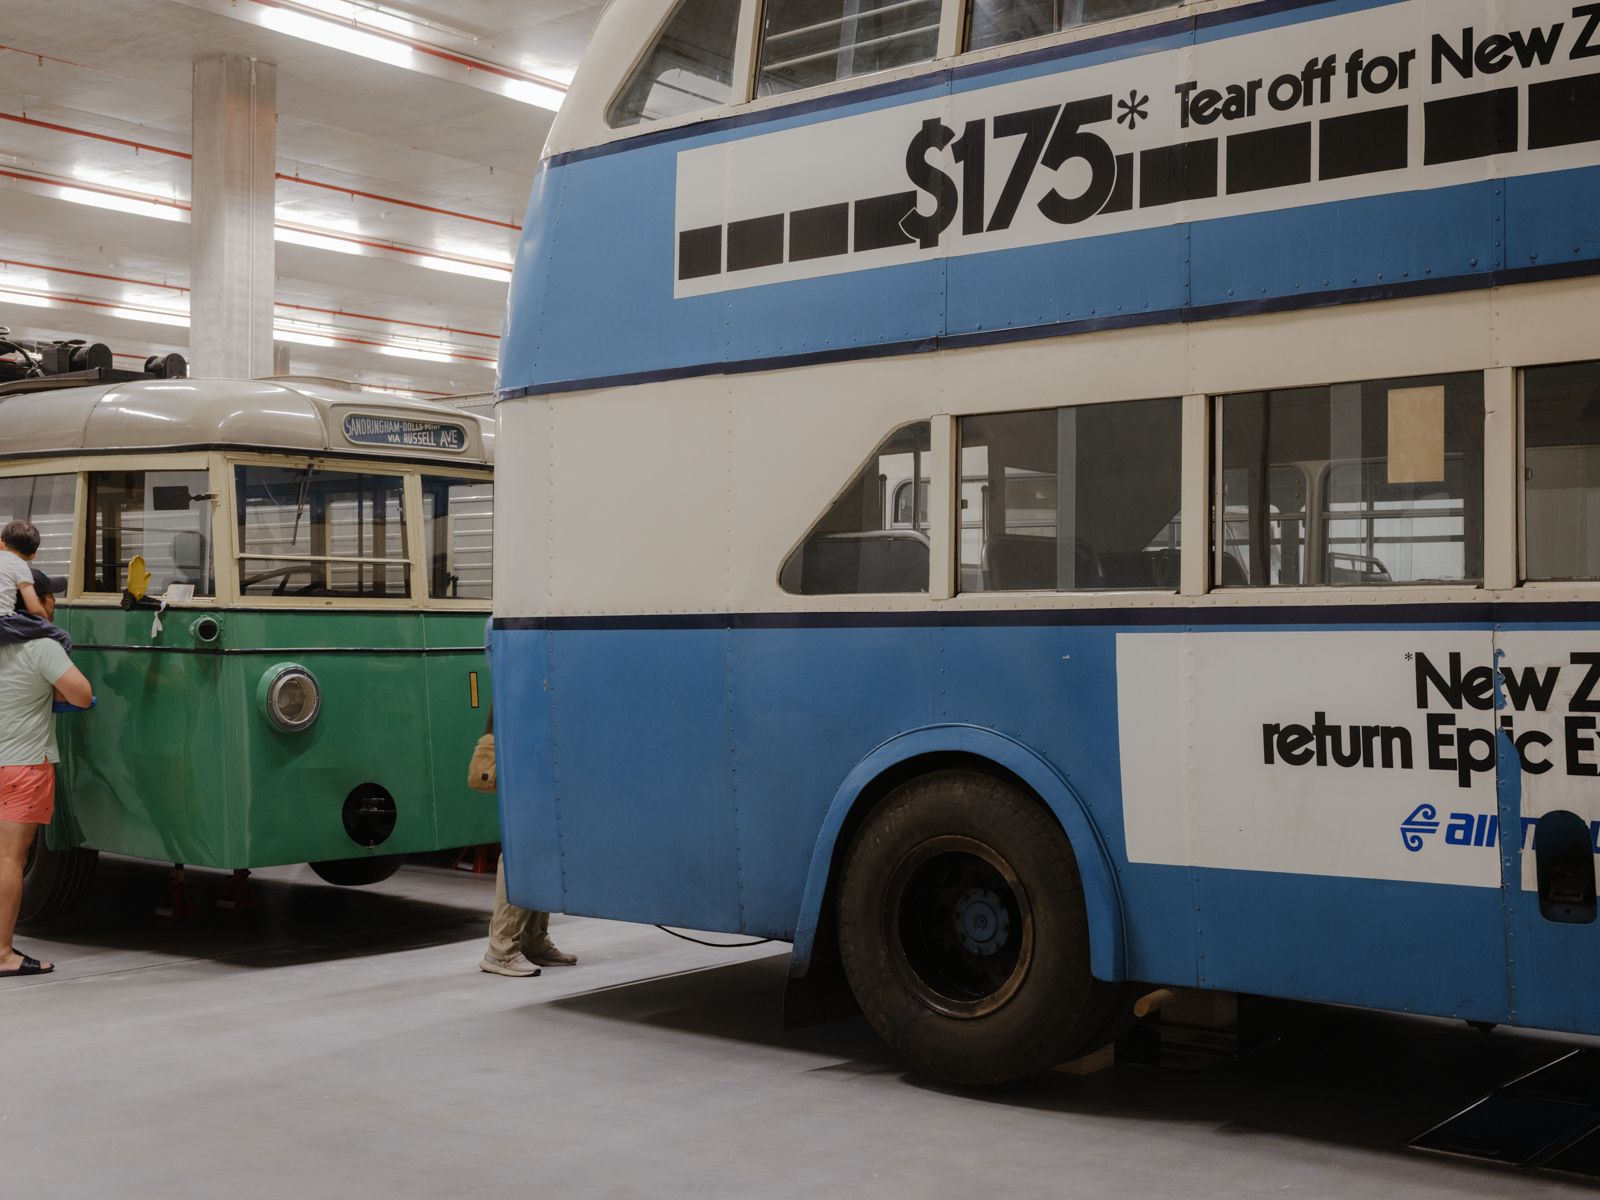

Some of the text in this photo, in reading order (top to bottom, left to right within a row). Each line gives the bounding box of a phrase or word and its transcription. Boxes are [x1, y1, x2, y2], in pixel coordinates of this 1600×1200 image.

[1175, 79, 1262, 128] Tear
[1267, 53, 1336, 111] off
[1345, 48, 1416, 99] for
[1431, 22, 1564, 84] New
[387, 429, 458, 448] VIA RUSSELL AVE
[1262, 711, 1413, 769] return
[1564, 715, 1600, 777] E
